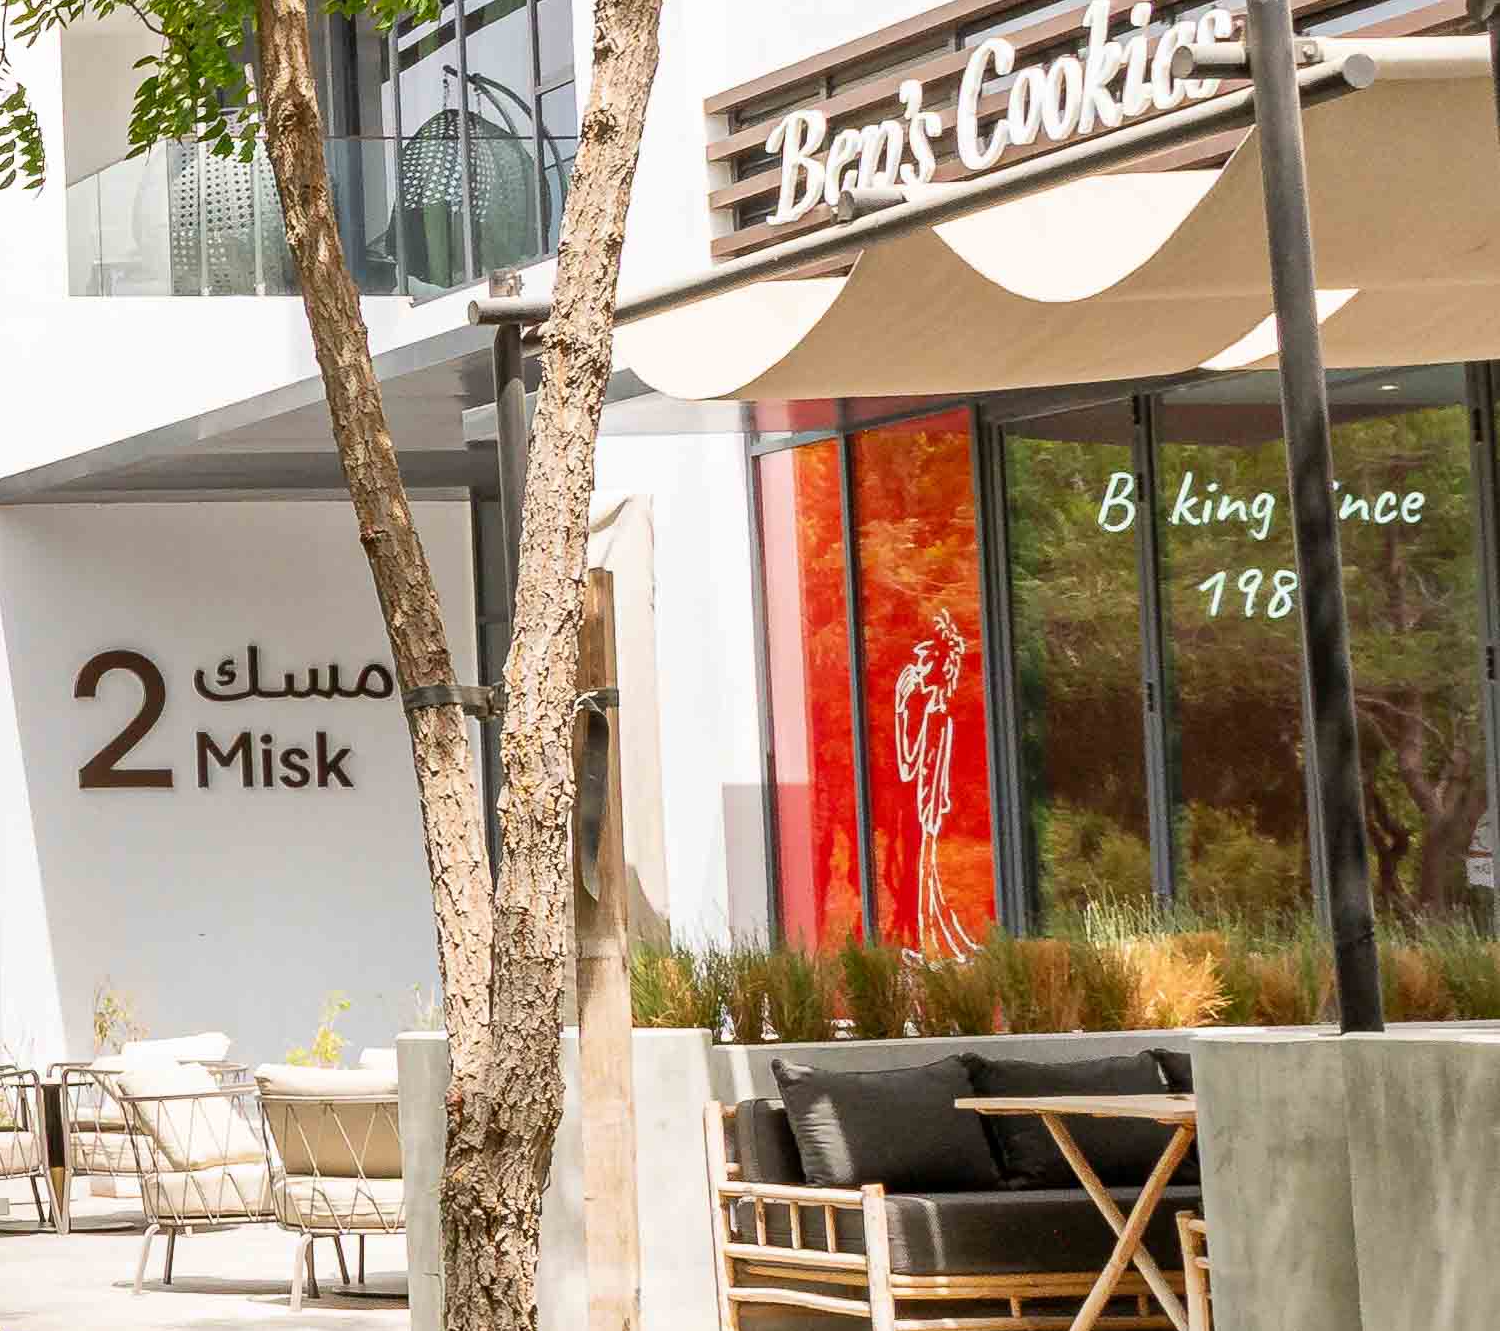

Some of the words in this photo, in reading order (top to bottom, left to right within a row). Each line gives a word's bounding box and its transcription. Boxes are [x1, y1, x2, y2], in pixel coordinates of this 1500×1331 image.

[766, 78, 943, 226] Ben's
[1098, 471, 1276, 541] Bking
[1331, 480, 1426, 525] nce
[193, 644, 395, 703] مسك
[73, 649, 174, 789] 2
[196, 730, 354, 788] Misk
